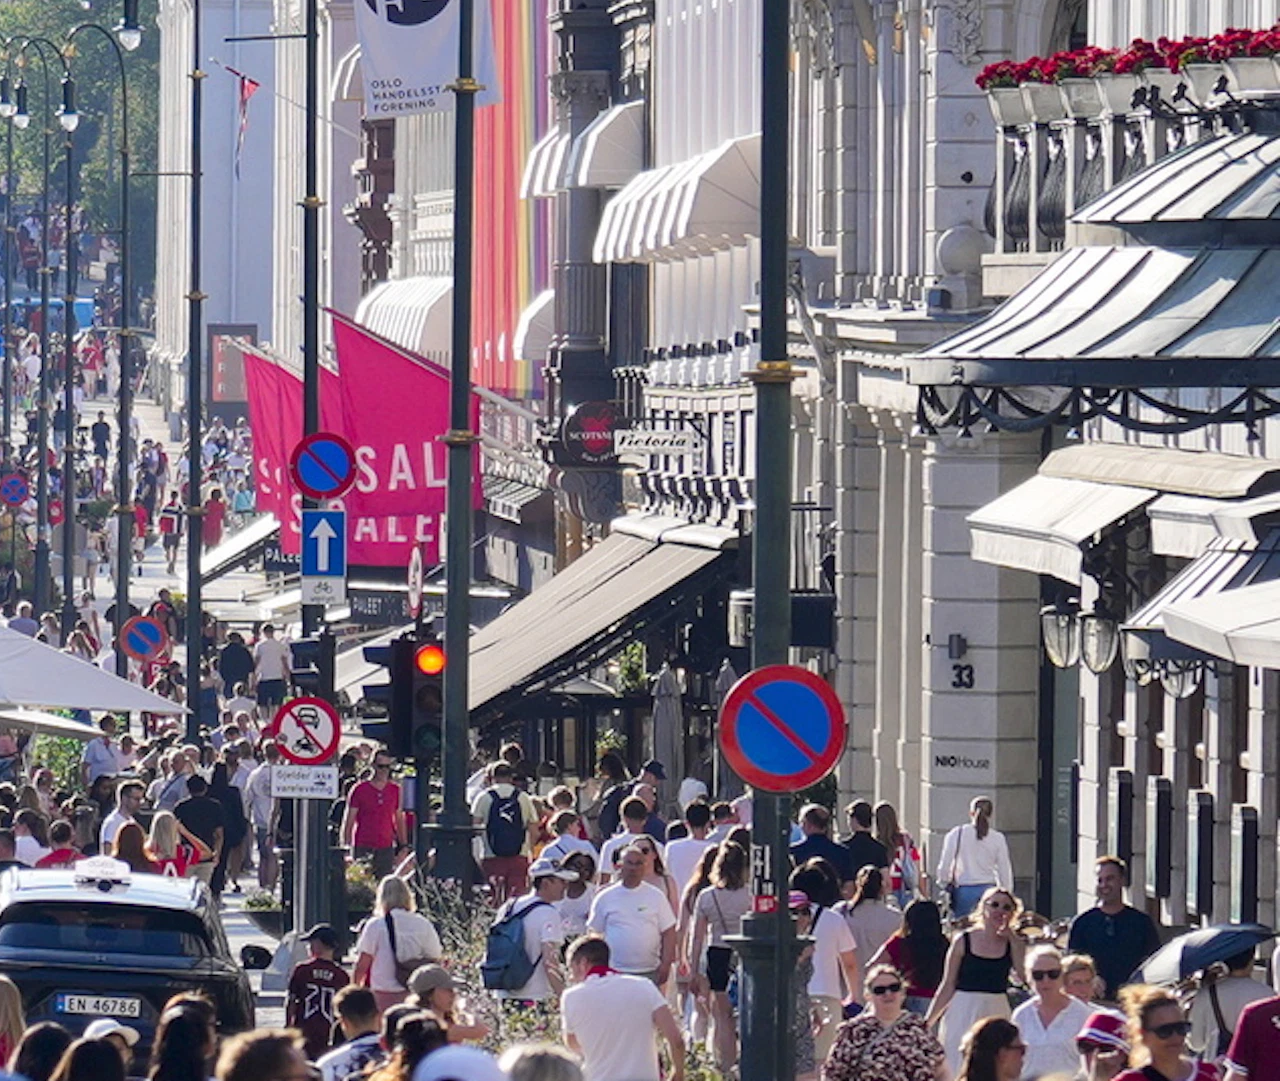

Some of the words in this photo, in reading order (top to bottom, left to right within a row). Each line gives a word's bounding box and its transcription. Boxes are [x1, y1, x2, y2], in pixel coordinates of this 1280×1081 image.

[370, 77, 403, 89] OSLO
[372, 85, 448, 101] HANDELSST
[373, 98, 437, 113] FORENING
[618, 433, 687, 448] Victoria
[355, 441, 452, 494] SAL
[951, 663, 976, 689] 33
[67, 997, 87, 1011] EN
[92, 998, 138, 1016] 46786
